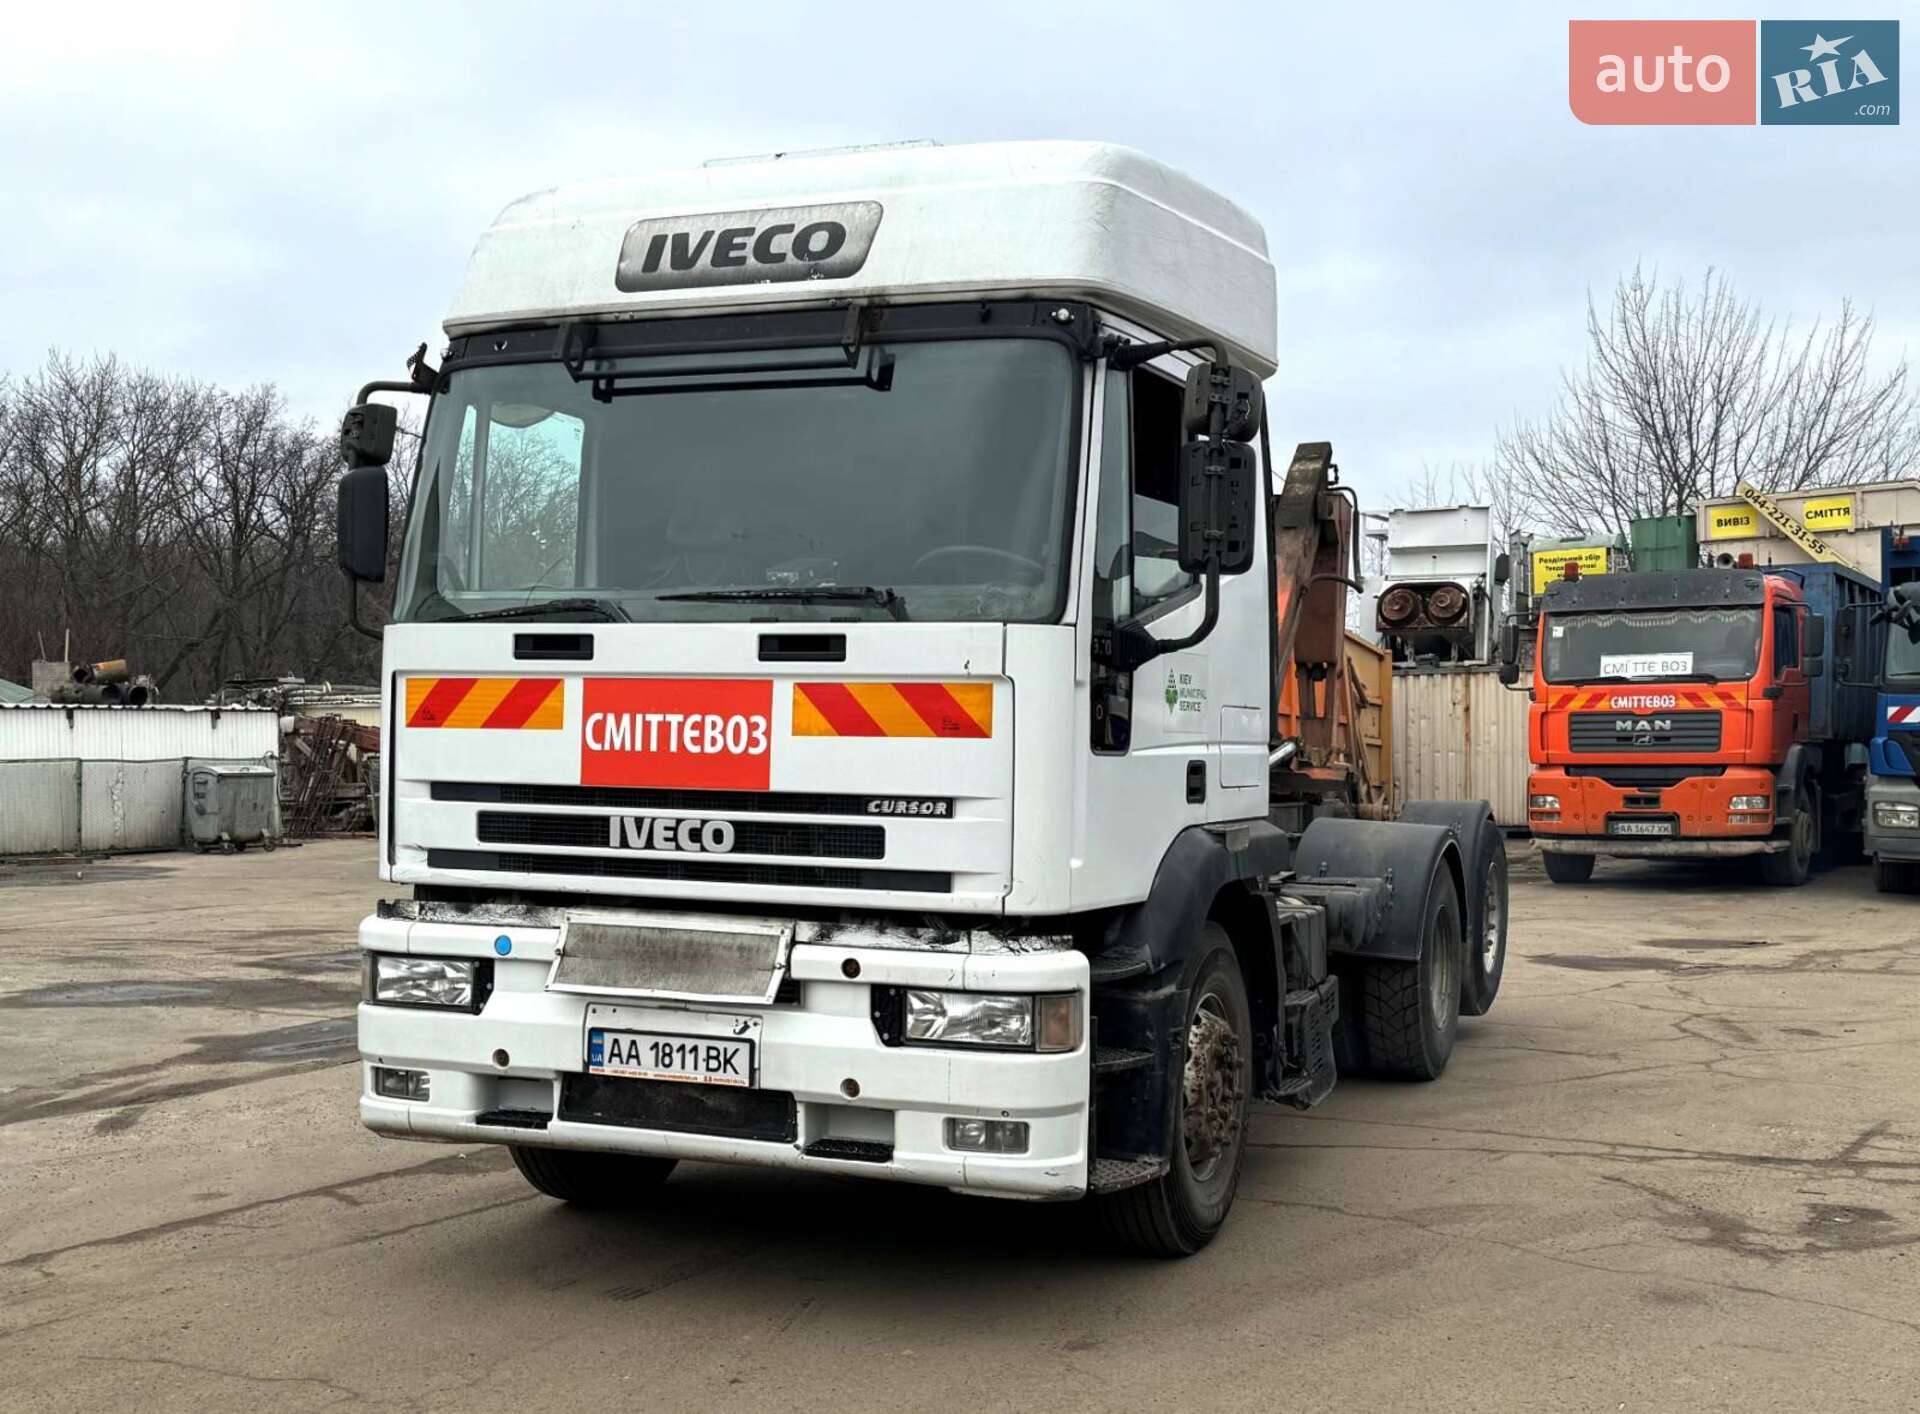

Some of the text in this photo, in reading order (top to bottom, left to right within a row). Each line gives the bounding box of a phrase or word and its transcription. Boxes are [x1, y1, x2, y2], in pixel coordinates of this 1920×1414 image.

[641, 221, 847, 273] IVECO
[1716, 516, 1750, 528] ВИВІЗ
[1744, 489, 1826, 555] 044-221-31-55
[1805, 506, 1851, 520] СМІТТЯ
[585, 712, 768, 755] СМІТТЄВОЗ
[1615, 719, 1671, 731] MAN
[866, 800, 947, 815] CURSOR
[609, 815, 736, 853] IVECO
[608, 1038, 740, 1075] AA 1811 BK
